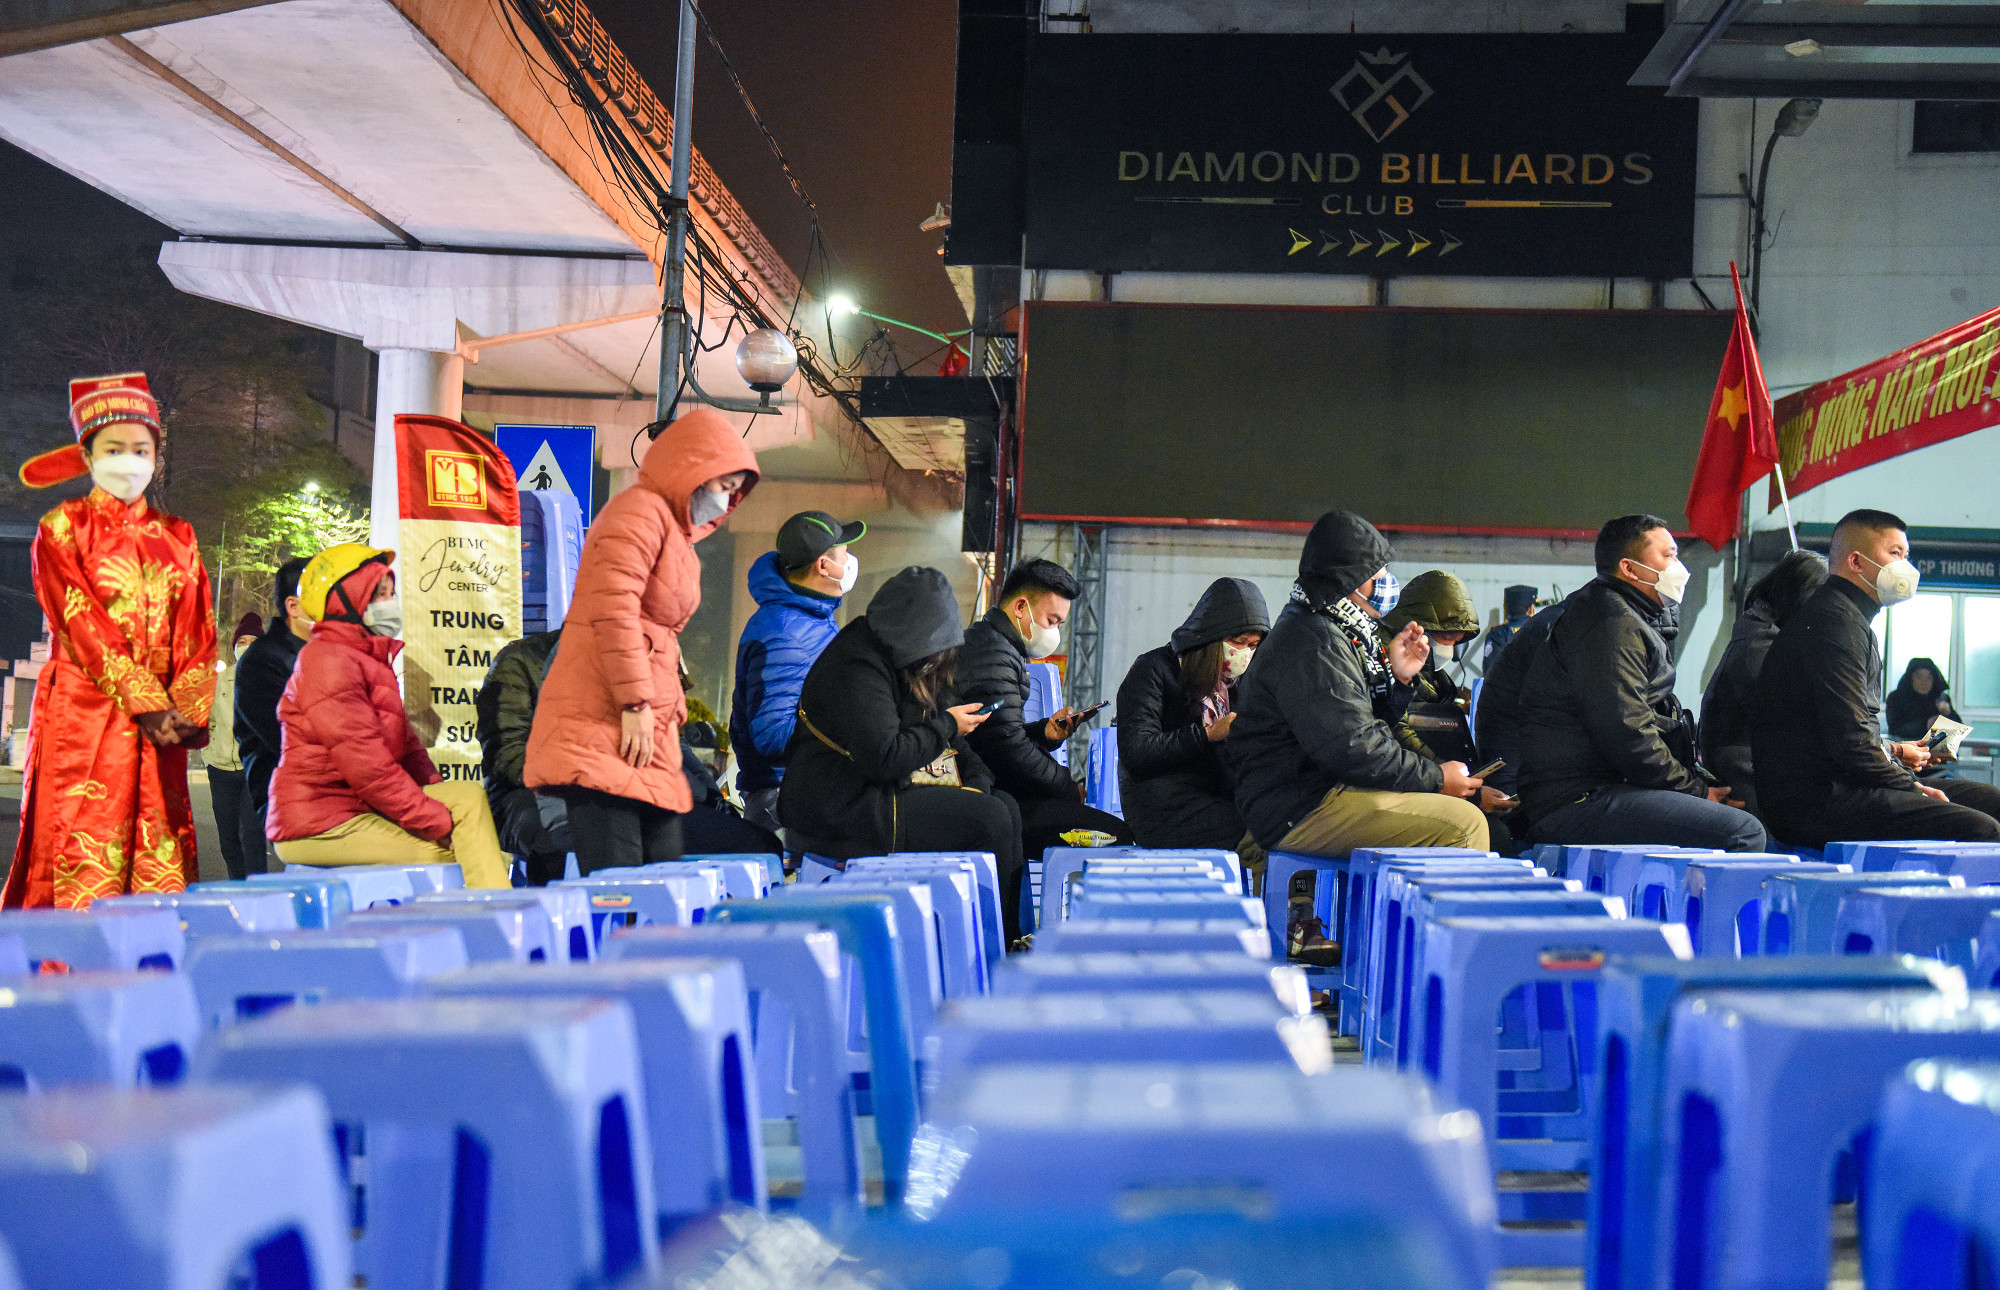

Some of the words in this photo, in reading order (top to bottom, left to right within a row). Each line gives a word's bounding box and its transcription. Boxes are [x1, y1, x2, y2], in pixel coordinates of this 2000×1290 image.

[1117, 151, 1360, 183] DIAMOND
[1381, 153, 1654, 185] BILLIARDS
[1321, 194, 1414, 215] CLUB
[1868, 348, 1940, 440] NĂM
[447, 536, 489, 550] BTMC
[419, 538, 509, 592] Jewelry
[448, 581, 488, 592] CENTER
[430, 610, 504, 630] TRUNG
[444, 644, 491, 667] TÂM
[447, 721, 475, 743] SỨ
[439, 763, 482, 781] BTM
